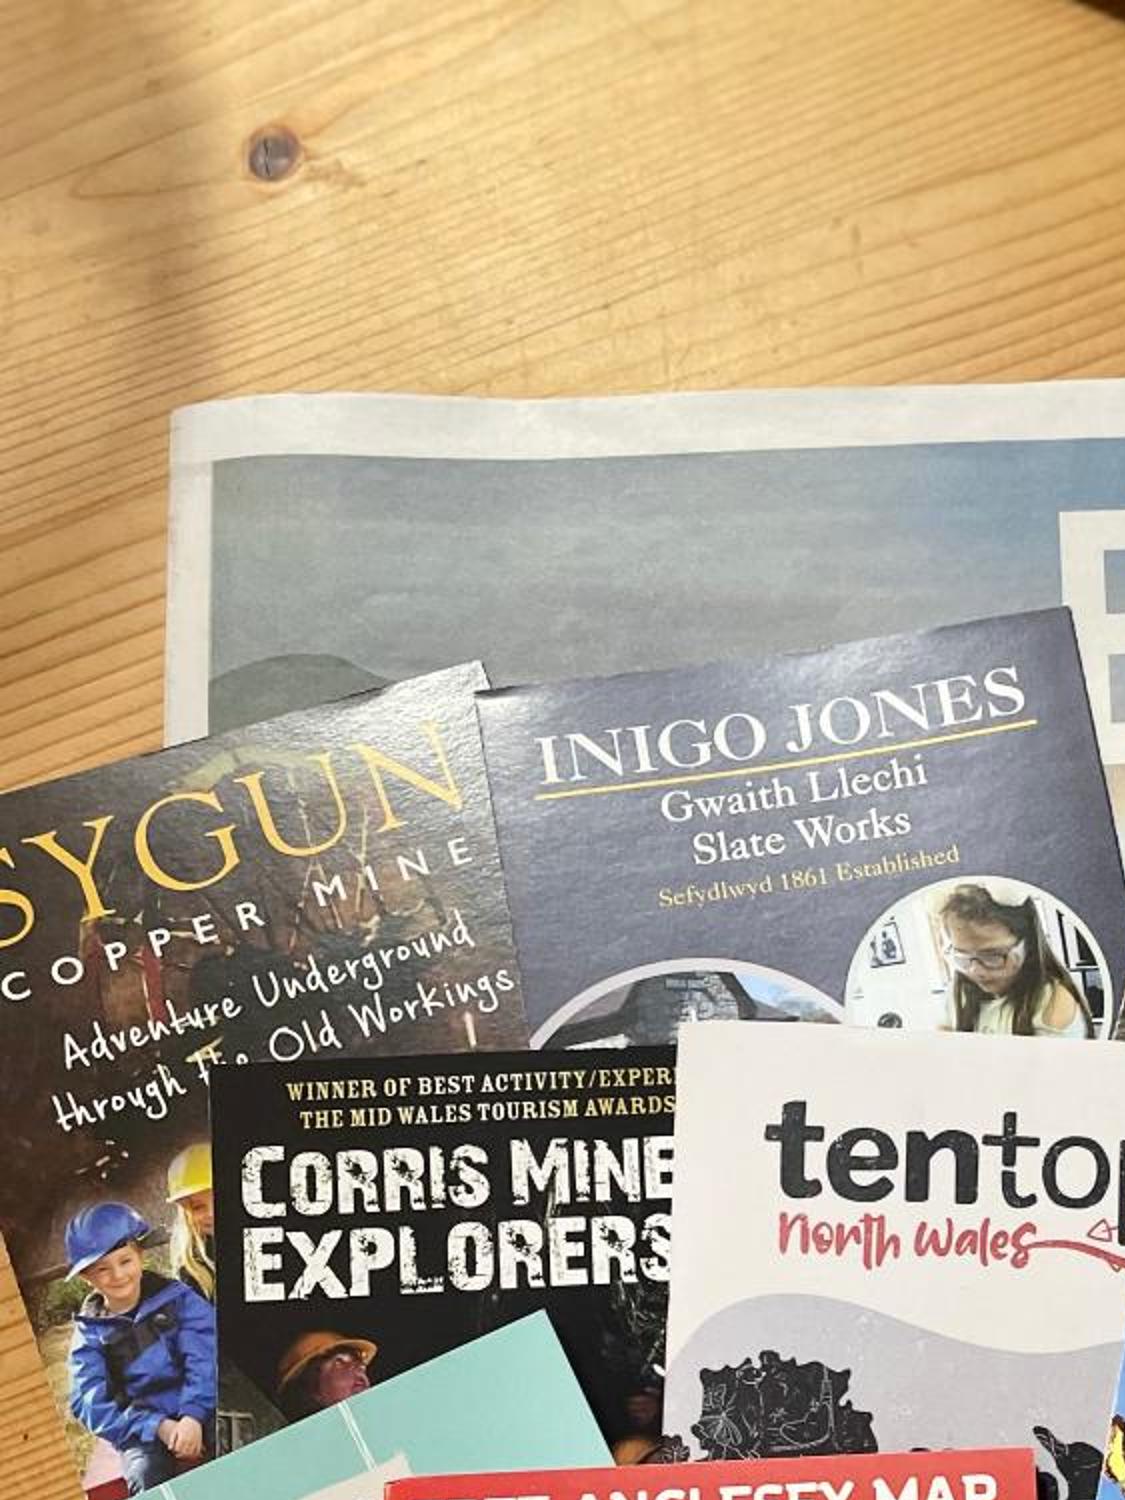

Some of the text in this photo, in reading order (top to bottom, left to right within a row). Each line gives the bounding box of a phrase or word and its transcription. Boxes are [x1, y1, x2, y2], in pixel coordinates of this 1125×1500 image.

[534, 665, 1026, 786] INIGO JONES
[661, 753, 929, 823] Gwaith Llechi
[0, 721, 463, 949] SYGUN
[658, 844, 960, 910] Sefydlwyd 1861 Established
[692, 806, 912, 865] Slate Works
[1, 837, 473, 1001] COPPER MINE
[63, 909, 475, 1071] Adventure Underground
[52, 1063, 186, 1132] through
[268, 1010, 342, 1062] Old
[347, 968, 514, 1040] Workings
[286, 1066, 677, 1101] WINNER OF BEST ACTIVITY/EXPER
[300, 1095, 676, 1129] THE MID WALES TOURISM AWARDS
[240, 1134, 674, 1219] CORRIS MINE
[241, 1211, 673, 1303] EXPLORERS
[914, 1218, 1038, 1272] Wales
